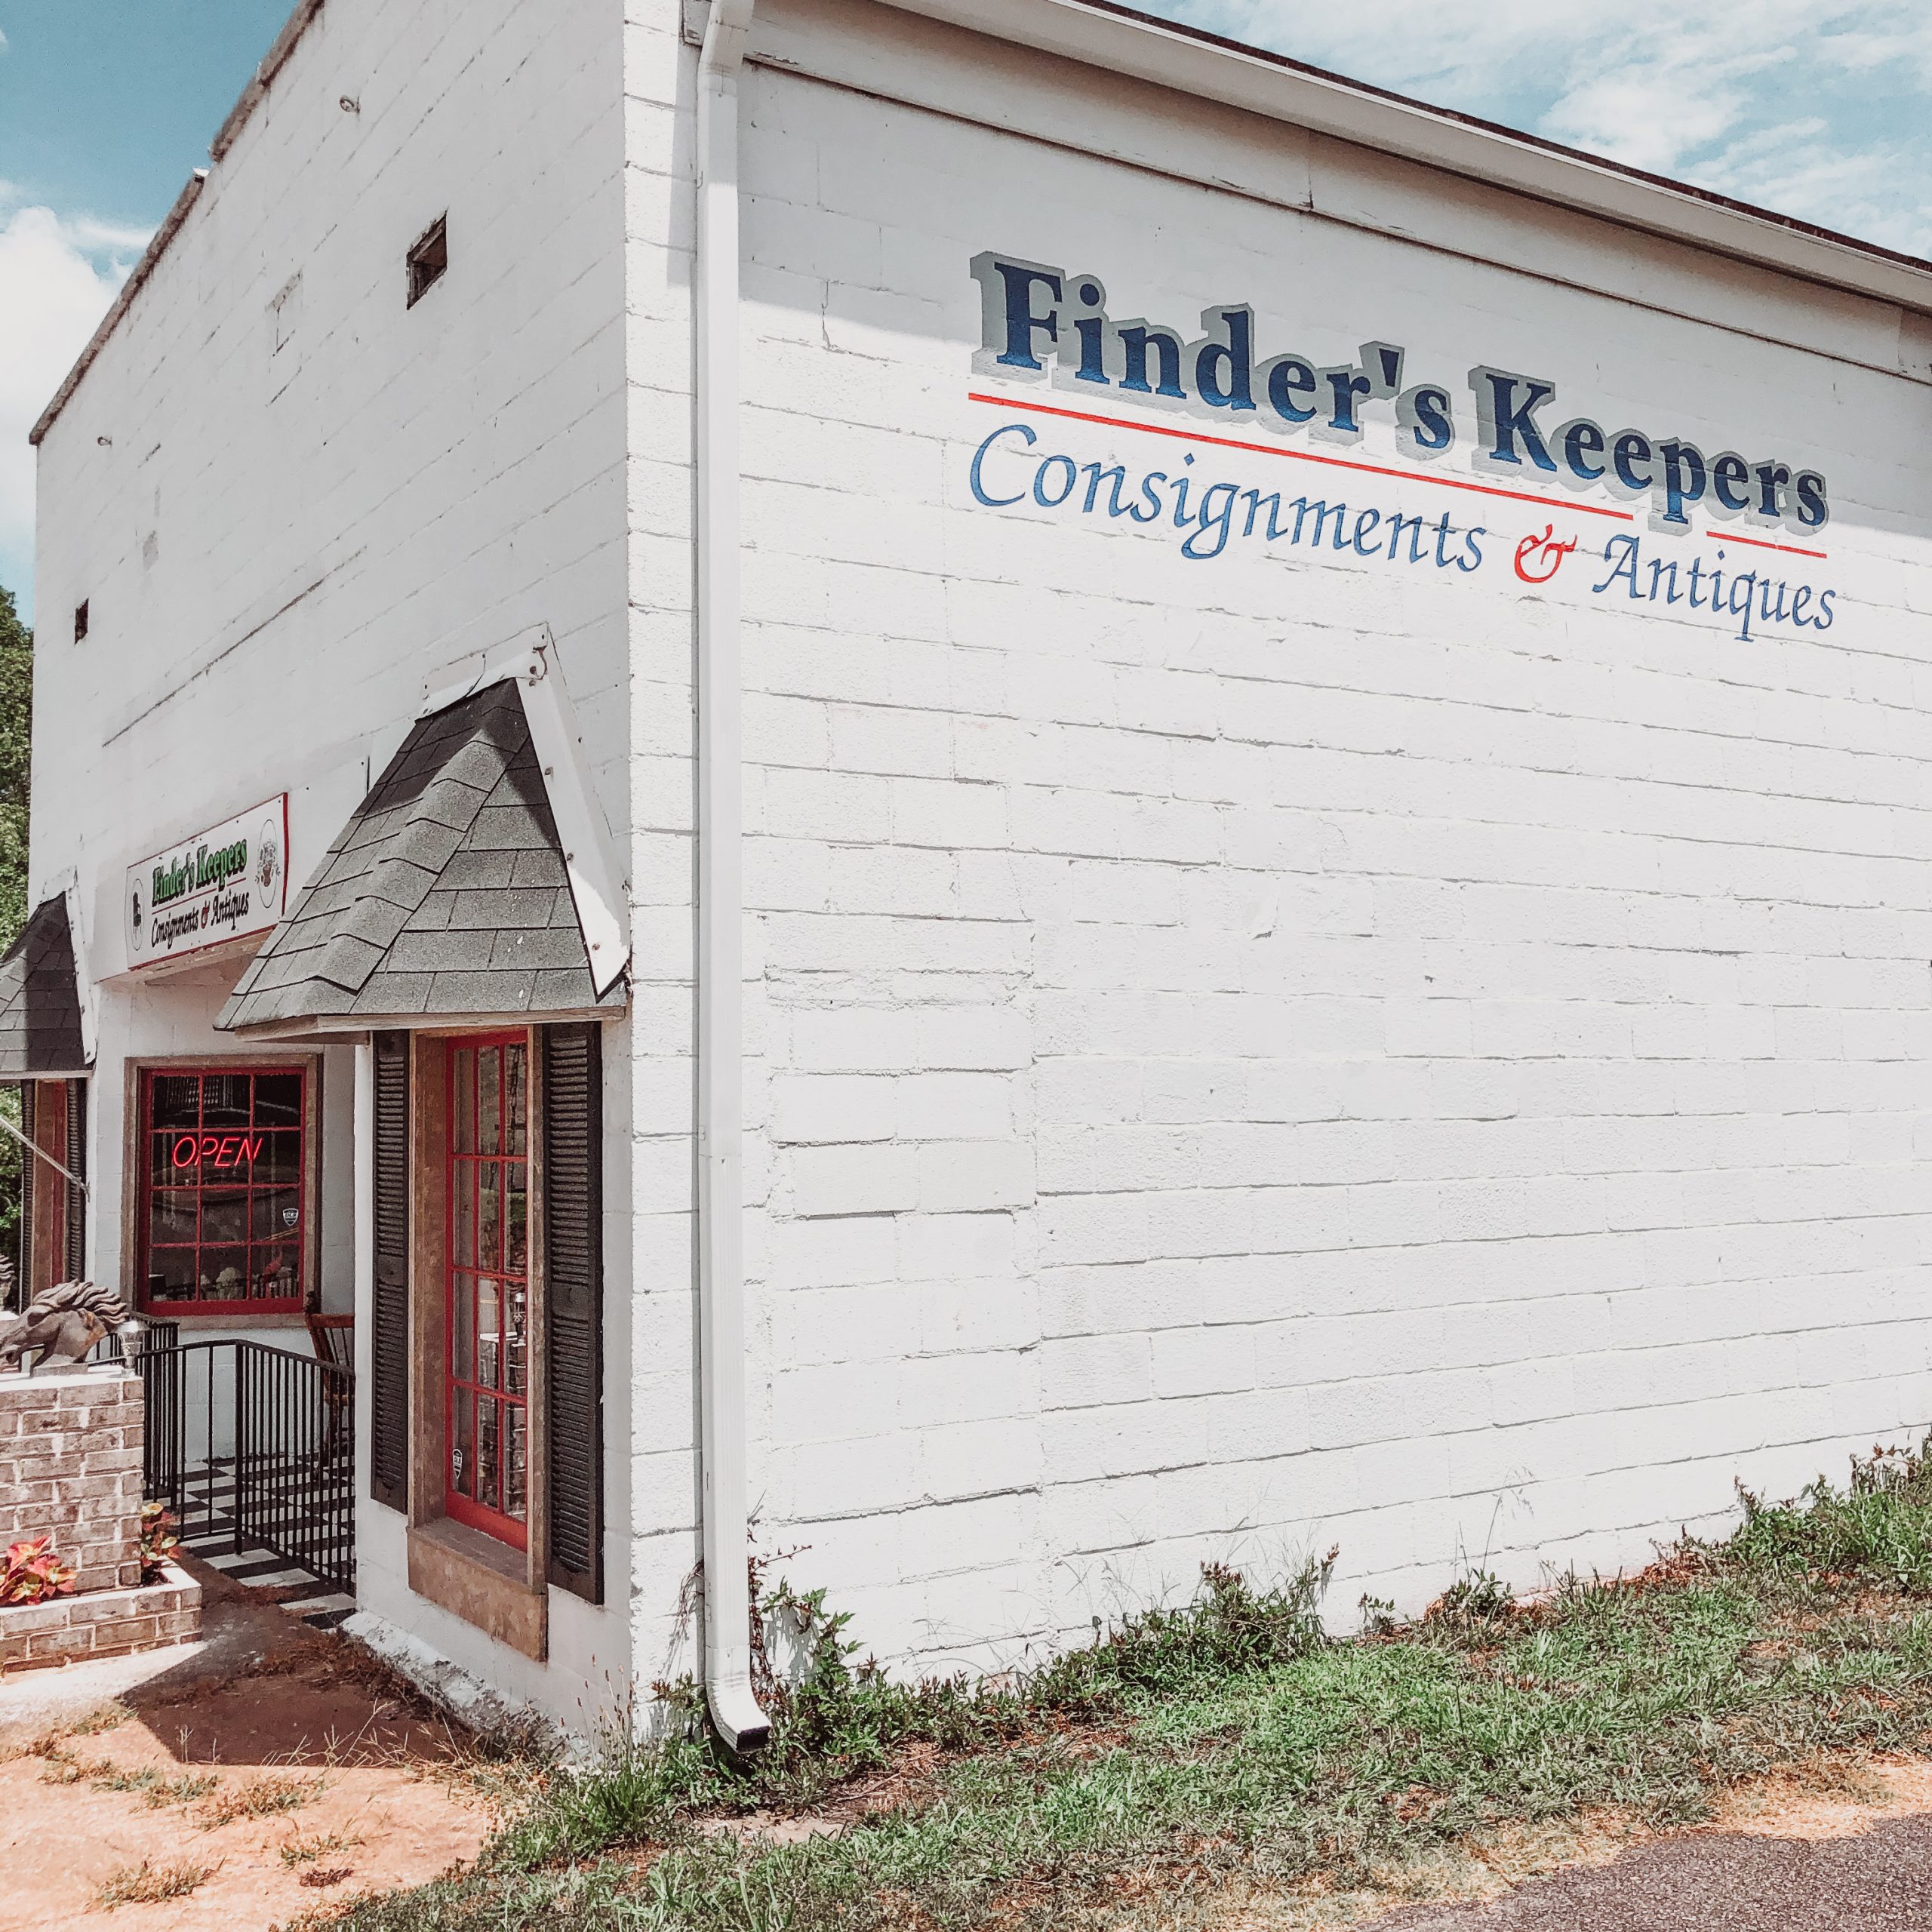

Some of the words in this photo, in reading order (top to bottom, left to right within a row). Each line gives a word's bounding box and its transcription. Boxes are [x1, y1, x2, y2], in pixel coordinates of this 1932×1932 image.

[992, 260, 1452, 450] Finder's
[1484, 371, 1827, 528] Keepers
[969, 423, 1487, 573] Consignments
[1513, 523, 1578, 583] &
[1592, 533, 1835, 643] Antiques
[152, 852, 195, 907] Finder's
[196, 838, 247, 892] Keepers
[152, 906, 199, 949] Consignments
[201, 900, 211, 929] &
[211, 889, 249, 931] Antiques
[173, 1136, 263, 1168] OPEN
